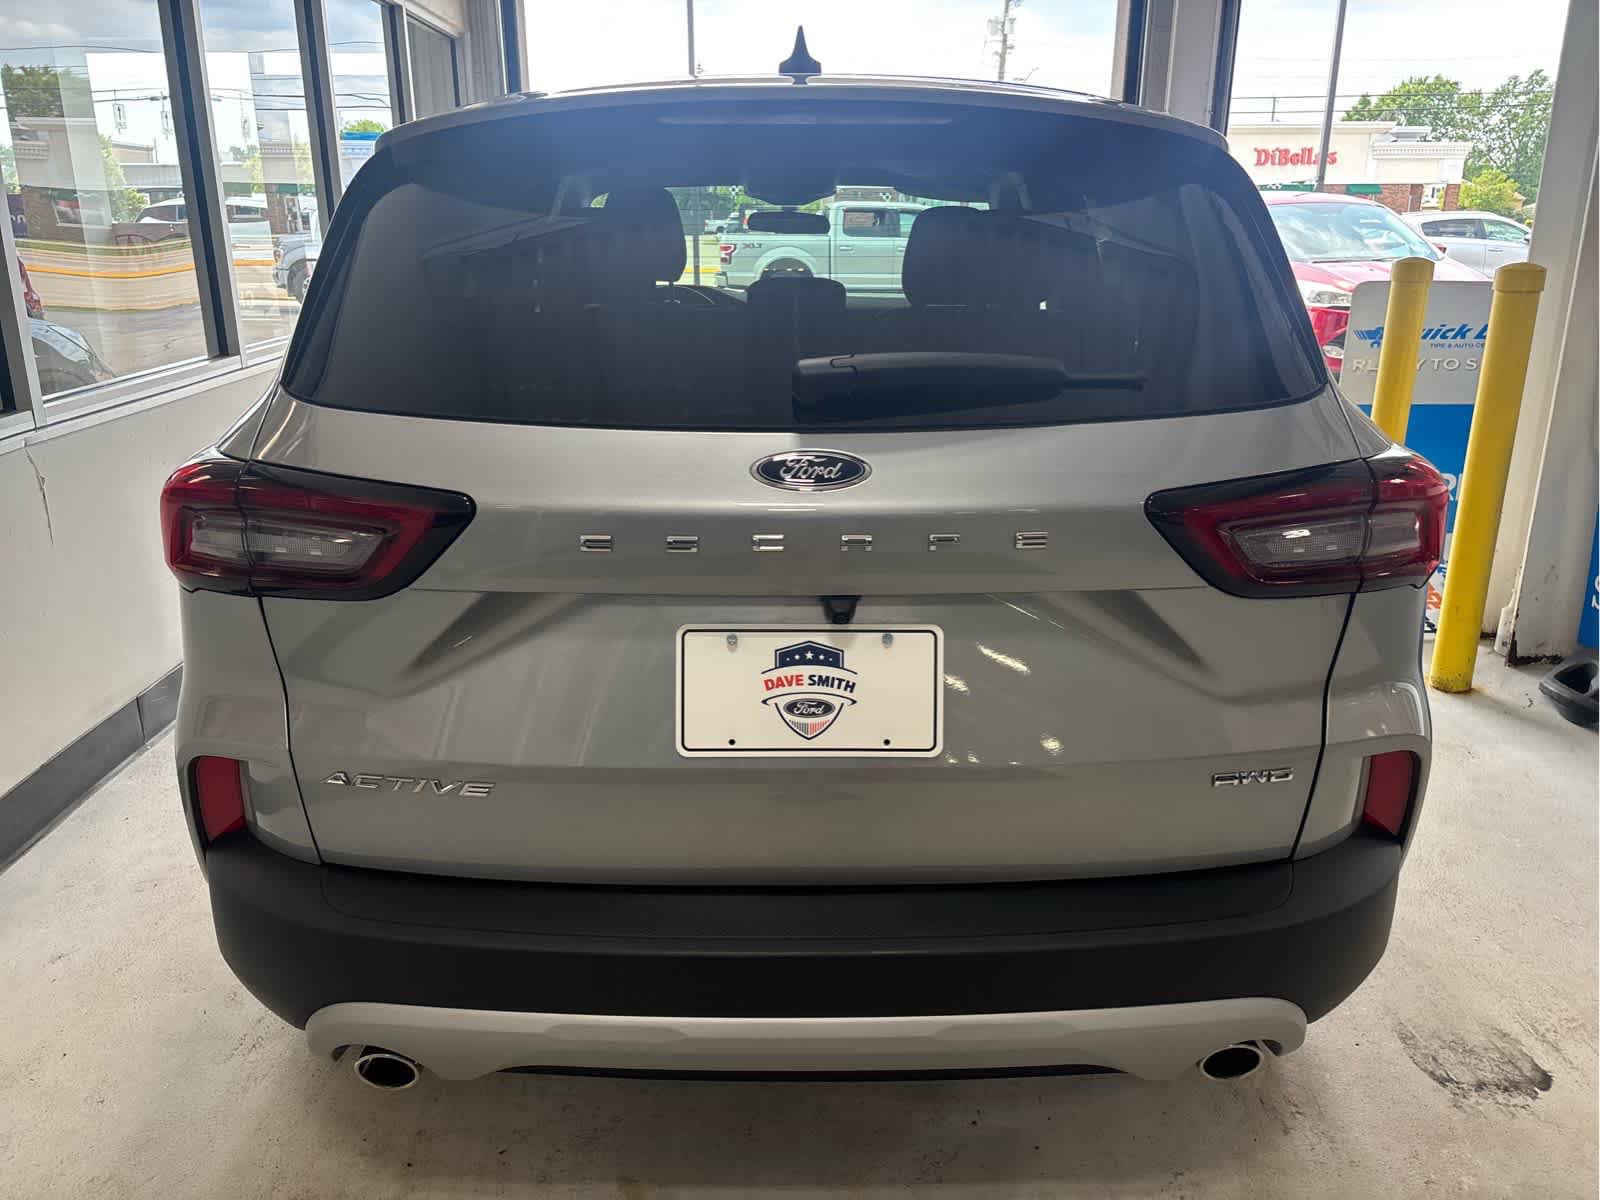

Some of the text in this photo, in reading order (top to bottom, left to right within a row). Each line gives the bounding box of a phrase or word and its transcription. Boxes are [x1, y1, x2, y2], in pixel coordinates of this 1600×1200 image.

[1254, 147, 1338, 167] DiBellas
[1420, 323, 1473, 340] uick
[1431, 358, 1459, 370] TO
[579, 530, 1049, 552] ESCAPE
[763, 674, 856, 694] DAVE SMITH
[793, 701, 825, 716] Ford
[320, 771, 496, 797] ACTIVE
